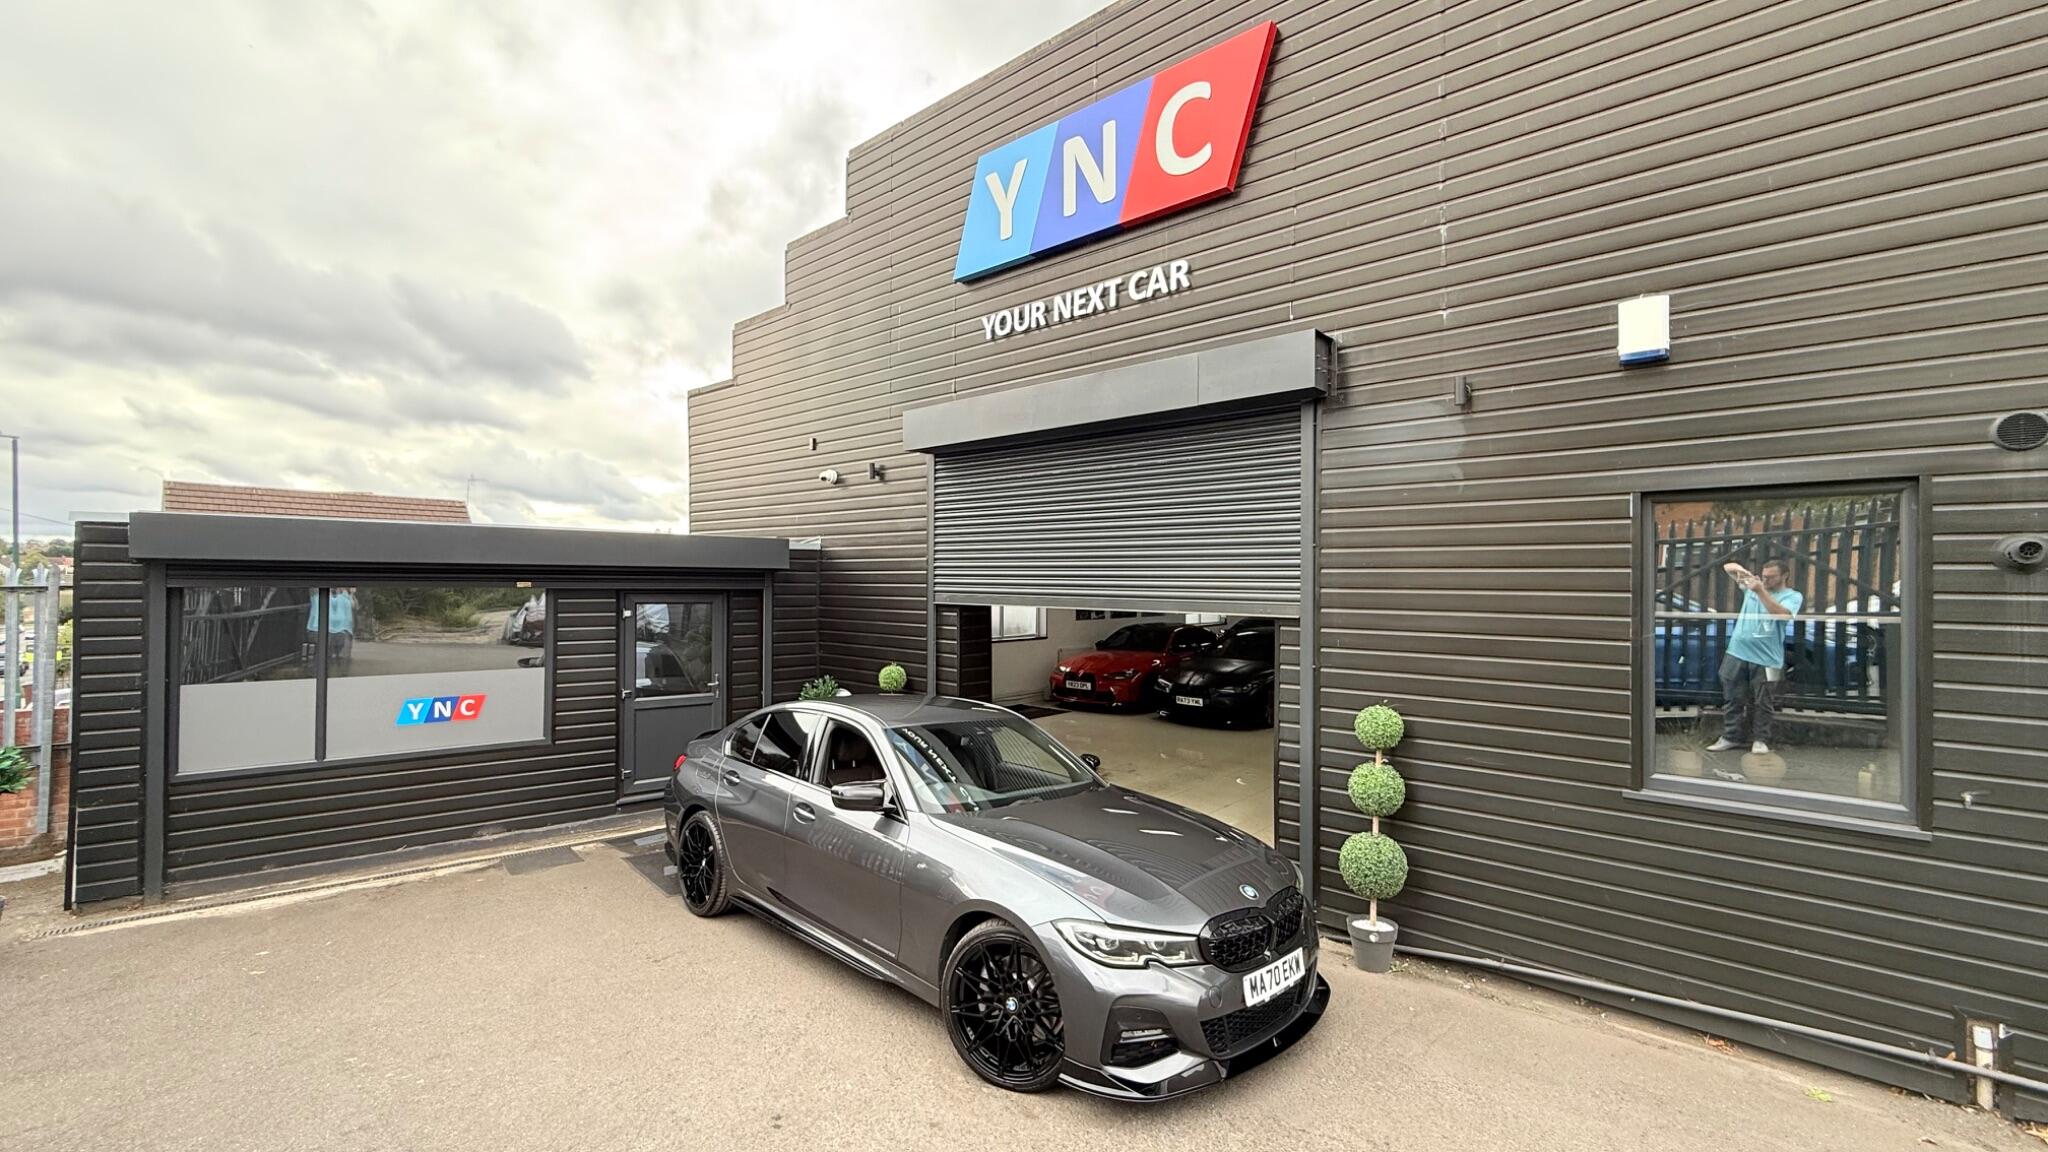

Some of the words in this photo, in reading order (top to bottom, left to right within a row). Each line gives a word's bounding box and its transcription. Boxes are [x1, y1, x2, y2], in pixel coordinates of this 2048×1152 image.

[985, 81, 1212, 241] YNC
[981, 301, 1046, 340] YOUR
[1053, 281, 1122, 323] NEXT
[1129, 259, 1192, 300] CAR
[407, 699, 475, 720] YNC
[1249, 965, 1281, 999] MA70
[1282, 953, 1302, 982] EKW
